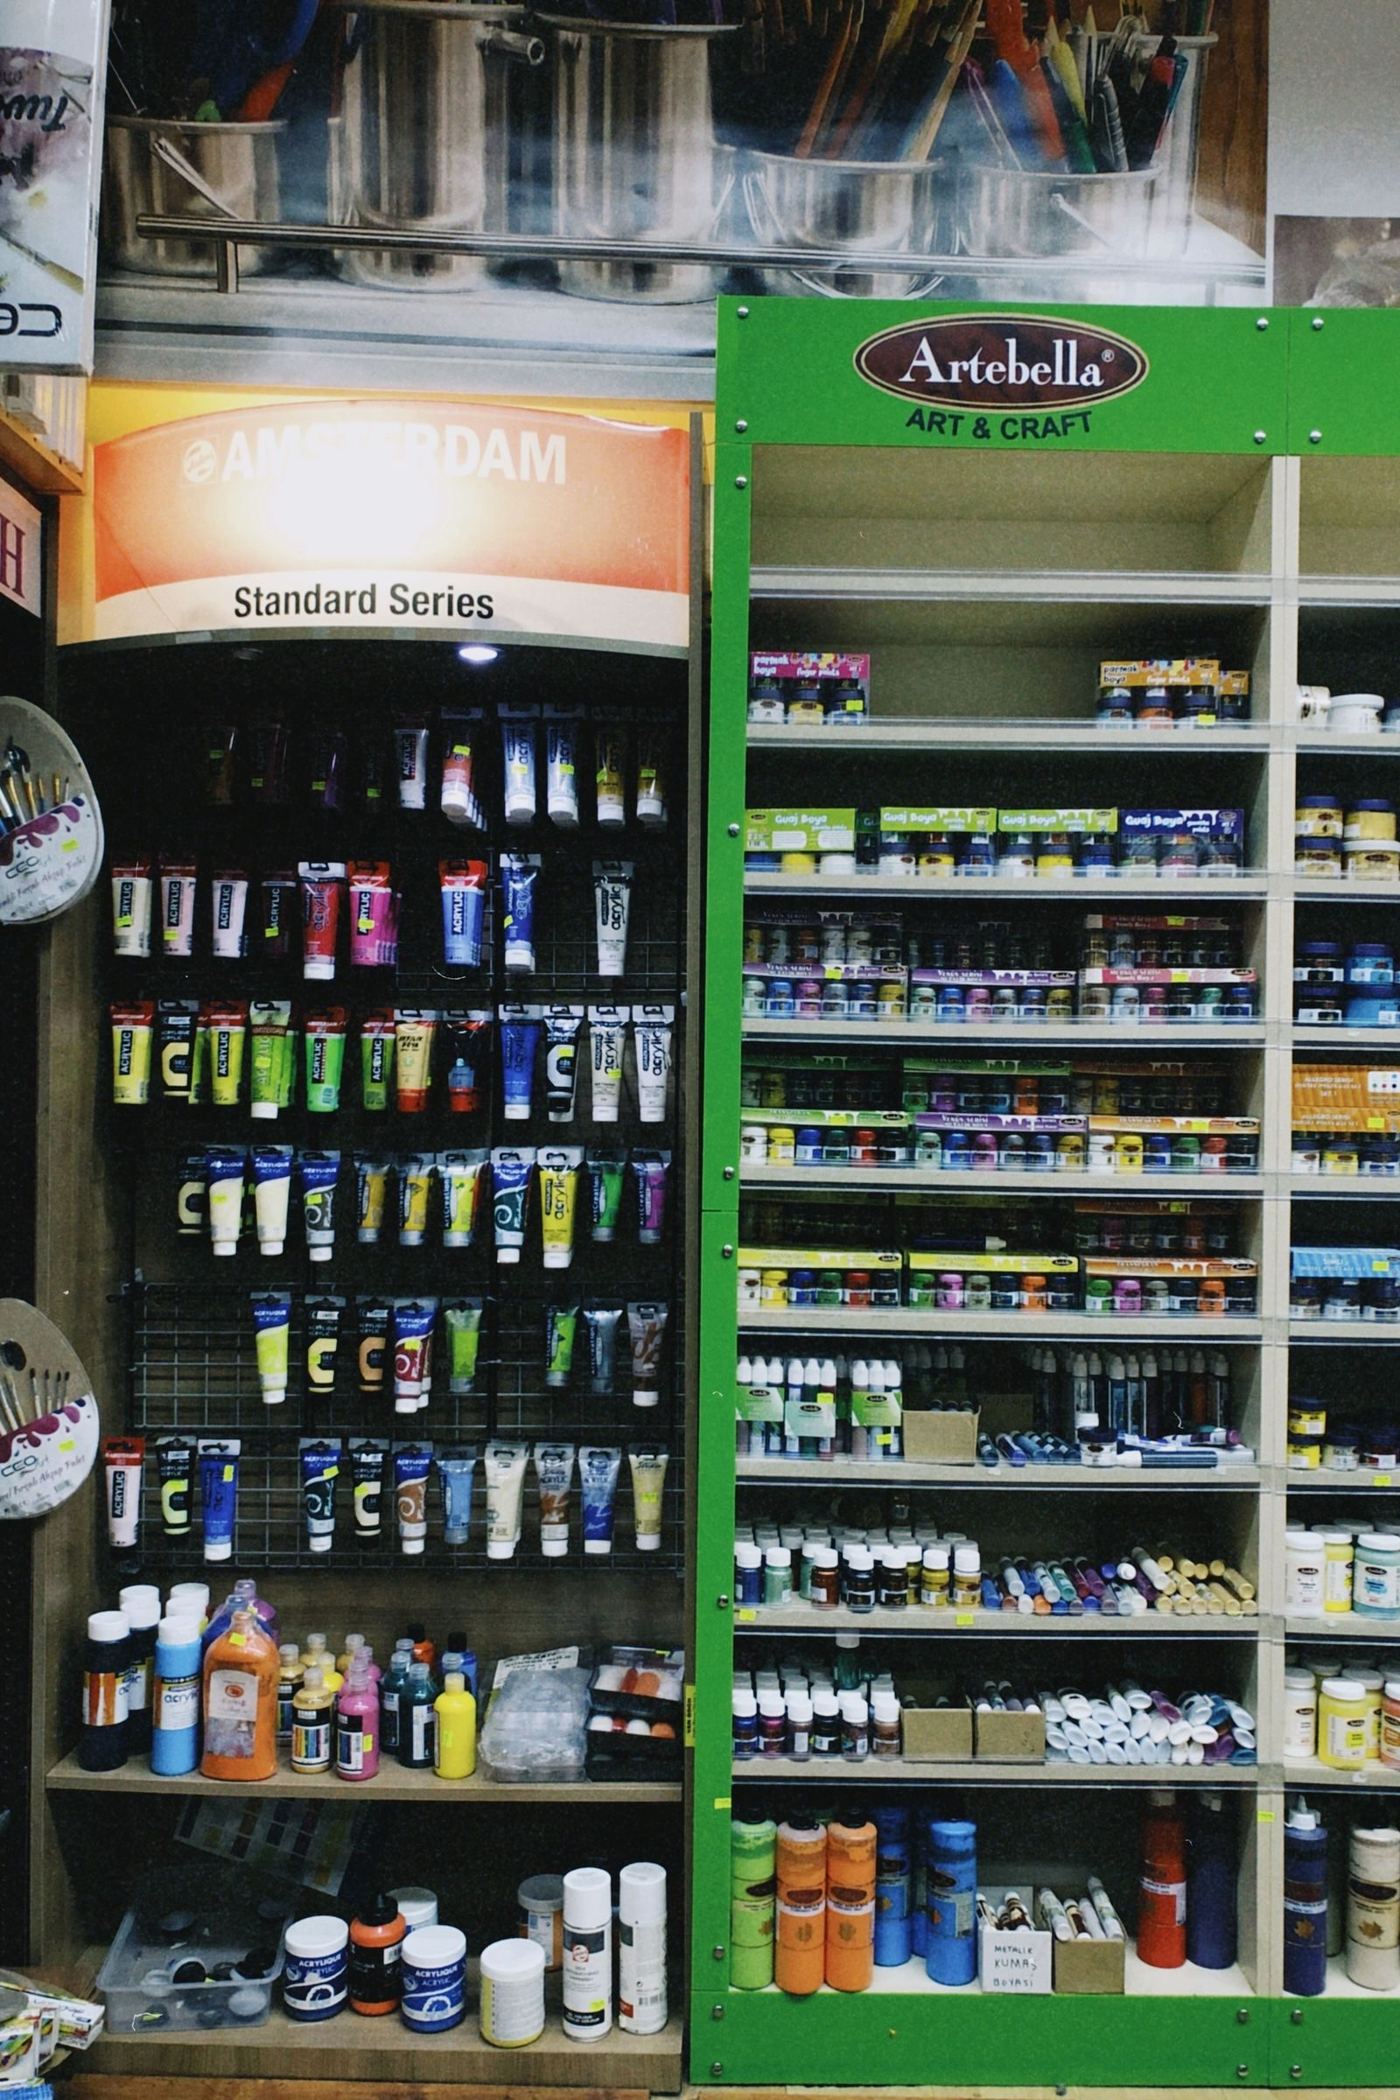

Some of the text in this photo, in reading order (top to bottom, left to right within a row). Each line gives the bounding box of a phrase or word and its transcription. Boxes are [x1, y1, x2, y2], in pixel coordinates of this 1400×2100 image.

[899, 336, 1104, 386] Artebella
[905, 408, 1092, 440] ART & CRAFT
[234, 583, 494, 620] Standard Series
[401, 738, 411, 776] ACRYLIC
[775, 812, 828, 826] Guaj Boya
[883, 811, 937, 824] Guaj Boya
[1002, 813, 1057, 827] Guaj Boya
[1125, 813, 1185, 829] Guaj Boya
[5, 856, 40, 879] CEO
[168, 882, 180, 924] ACRYLIC
[220, 886, 232, 928] ACRYLIC
[313, 887, 328, 932] acrylic
[360, 893, 371, 933] ARYLIC
[452, 891, 464, 934] ACRYLIC
[609, 885, 624, 931] acrylic
[120, 1031, 132, 1074] ACRYLIC
[218, 1032, 230, 1075] ACRYLIC
[312, 1042, 322, 1080] ACRYLIC
[371, 1039, 383, 1081] ACRYLIC
[604, 1031, 617, 1074] acrylic
[651, 1030, 664, 1076] acrylic
[554, 1173, 567, 1220] acrylic
[1, 1455, 37, 1477] CEO
[113, 1471, 125, 1515] ACRYLIC
[299, 1954, 342, 1968] ACRYLIQUE
[415, 1966, 458, 1978] ACRYLIQUE
[422, 1976, 452, 1986] ACRYLIC
